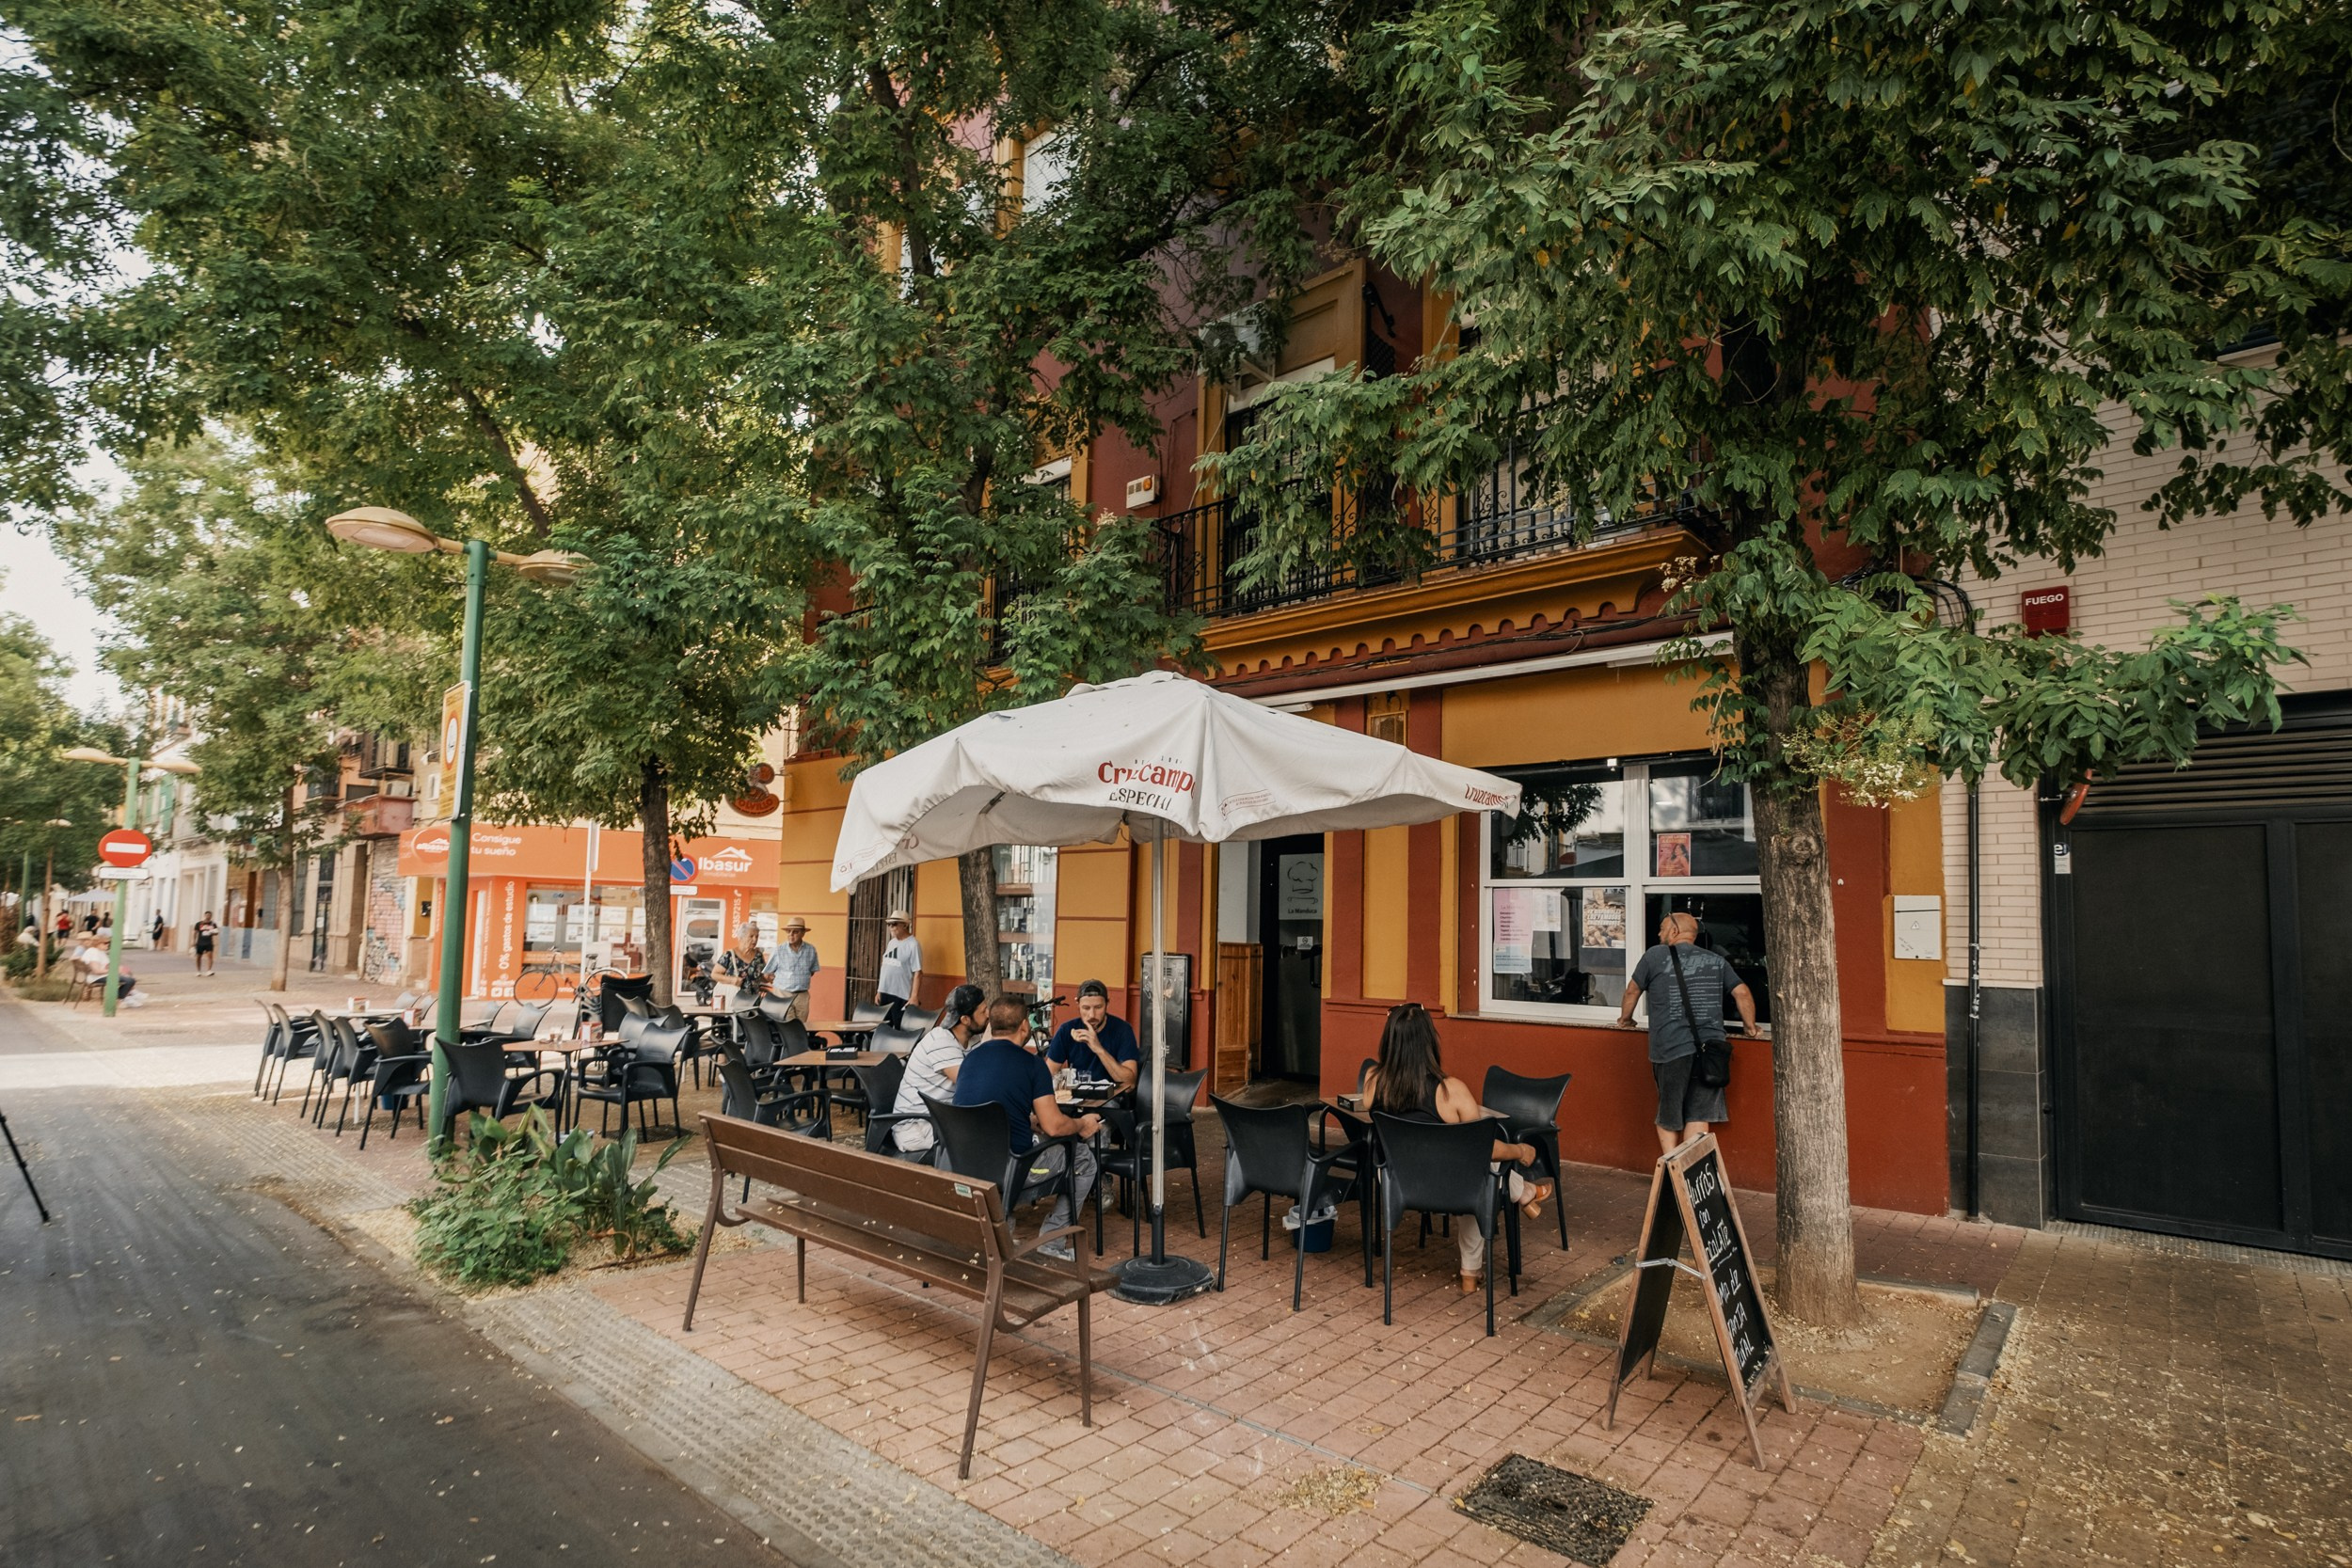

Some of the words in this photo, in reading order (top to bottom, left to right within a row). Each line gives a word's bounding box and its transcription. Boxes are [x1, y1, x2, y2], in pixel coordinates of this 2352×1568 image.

[2026, 594, 2064, 606] FUEGO
[471, 832, 522, 846] Consigue
[471, 847, 483, 855] tu
[485, 847, 516, 856] sueño
[505, 881, 515, 911] estudio
